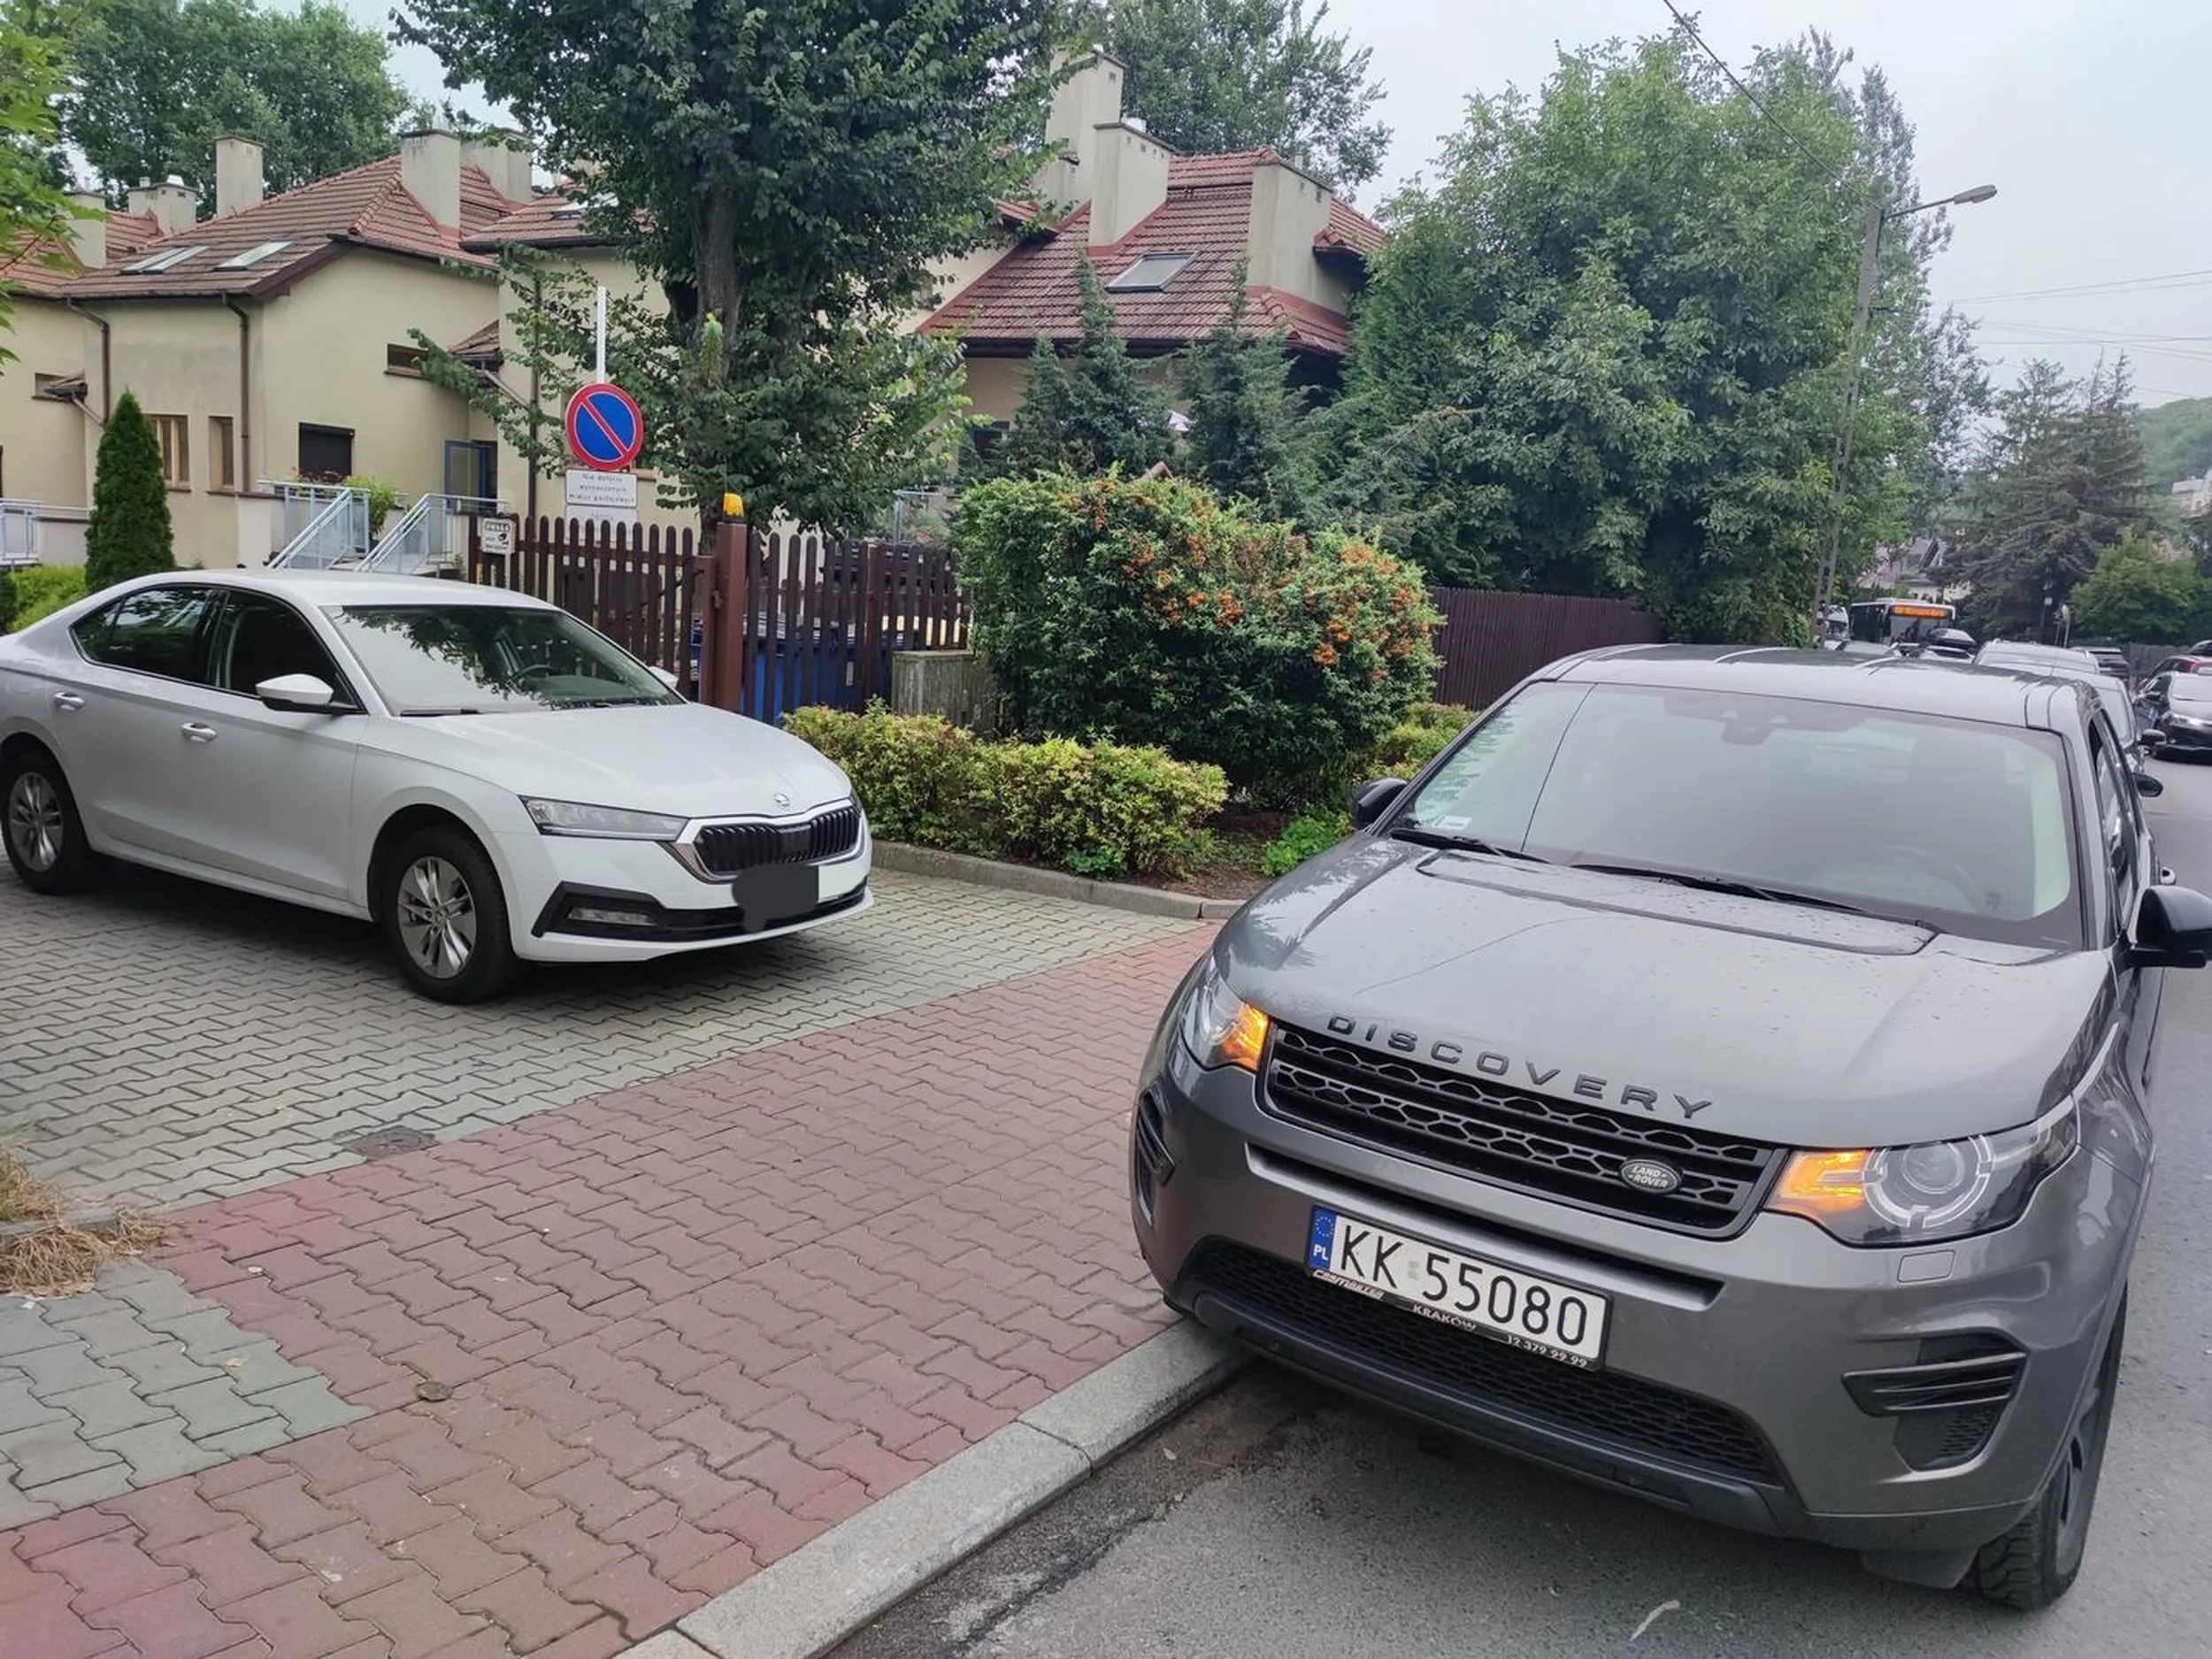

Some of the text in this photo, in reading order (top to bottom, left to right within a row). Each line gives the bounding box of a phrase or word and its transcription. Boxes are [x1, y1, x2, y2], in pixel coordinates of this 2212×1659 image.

[1327, 1015, 1712, 1119] DISCOVERY
[1632, 1165, 1661, 1178] LAND
[1633, 1174, 1668, 1187] ROVER
[1313, 1243, 1328, 1261] PL
[1341, 1225, 1586, 1346] KK 55080
[1412, 1302, 1477, 1332] KRAKÓW
[1507, 1335, 1521, 1347] 12
[1523, 1340, 1547, 1356] 379
[1550, 1348, 1567, 1362] 99
[1570, 1355, 1588, 1369] 99
